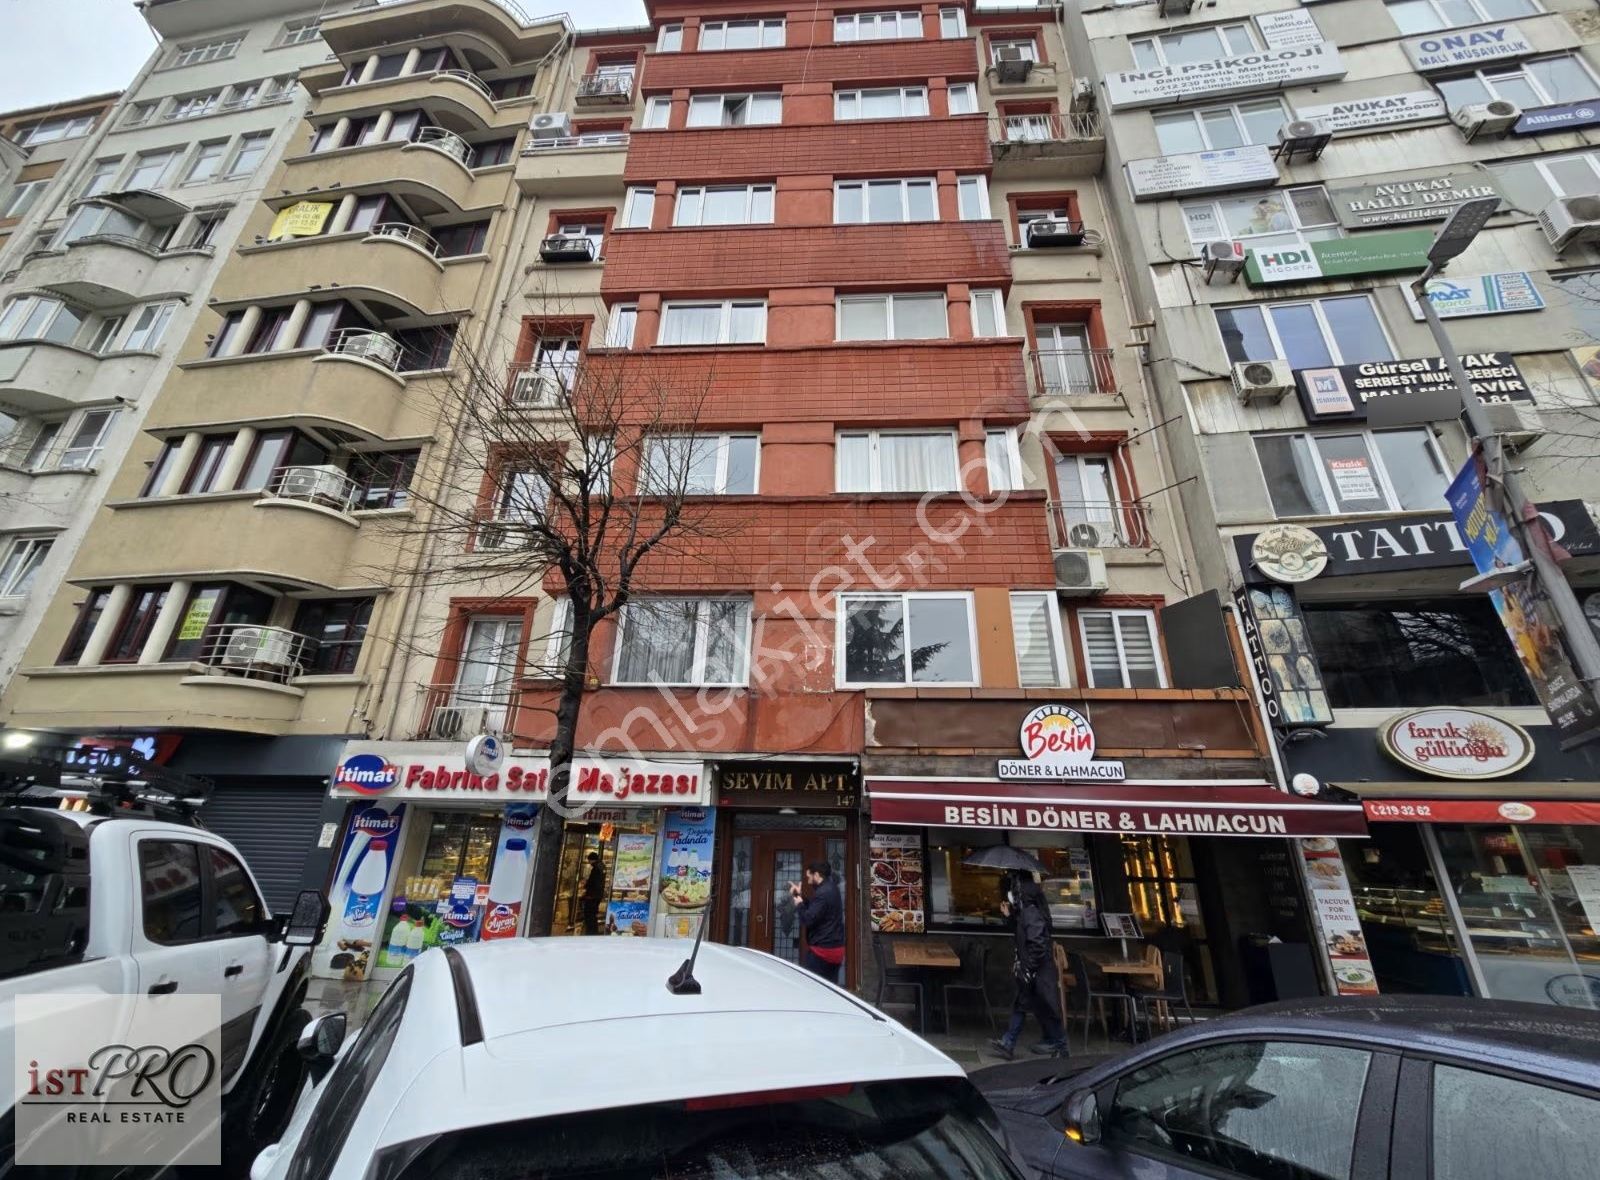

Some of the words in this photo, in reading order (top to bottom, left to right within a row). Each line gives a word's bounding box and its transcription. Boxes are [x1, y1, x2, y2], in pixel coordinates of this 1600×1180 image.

[1420, 28, 1505, 52] ONAY
[1119, 66, 1173, 84] İNCİ
[1182, 44, 1324, 73] PSİKOLOJİ
[1237, 61, 1290, 74] Merkezi
[1332, 97, 1408, 115] AVUKAT
[1526, 111, 1576, 125] Allianz
[1375, 177, 1453, 197] AVUKAT
[1349, 195, 1415, 212] HALİL
[1422, 185, 1496, 204] DEMİR
[1260, 250, 1312, 267] HDI
[1354, 374, 1416, 389] SERBEST
[1420, 364, 1518, 386] MUHSEBECİ
[1359, 360, 1431, 376] Gürsel
[1332, 511, 1567, 563] TATTO
[1237, 594, 1279, 718] TATTOO
[1408, 721, 1465, 739] faruk
[1024, 722, 1092, 759] Besin
[1415, 739, 1505, 763] güllüoğlu
[1000, 762, 1042, 776] DÖNER
[1045, 766, 1053, 776] &
[1055, 765, 1123, 778] LAHMACUN
[337, 766, 396, 784] itimat
[404, 765, 500, 791] Fabrika
[505, 766, 548, 792] Sat
[577, 767, 698, 799] Mağazası
[722, 769, 793, 791] SEVİM
[803, 772, 854, 791] APT.
[836, 795, 856, 807] 147
[582, 808, 627, 821] itimat
[681, 810, 705, 818] itimat
[944, 803, 1018, 828] BESİN
[1026, 806, 1113, 830] DÖNER
[1118, 812, 1135, 830] &
[1143, 813, 1288, 834] LAHMACUN
[1380, 805, 1400, 815] 219
[1401, 805, 1416, 815] 32
[1417, 805, 1431, 816] 62
[354, 817, 396, 829] itimat
[506, 818, 534, 828] itimat
[444, 912, 474, 921] itimat
